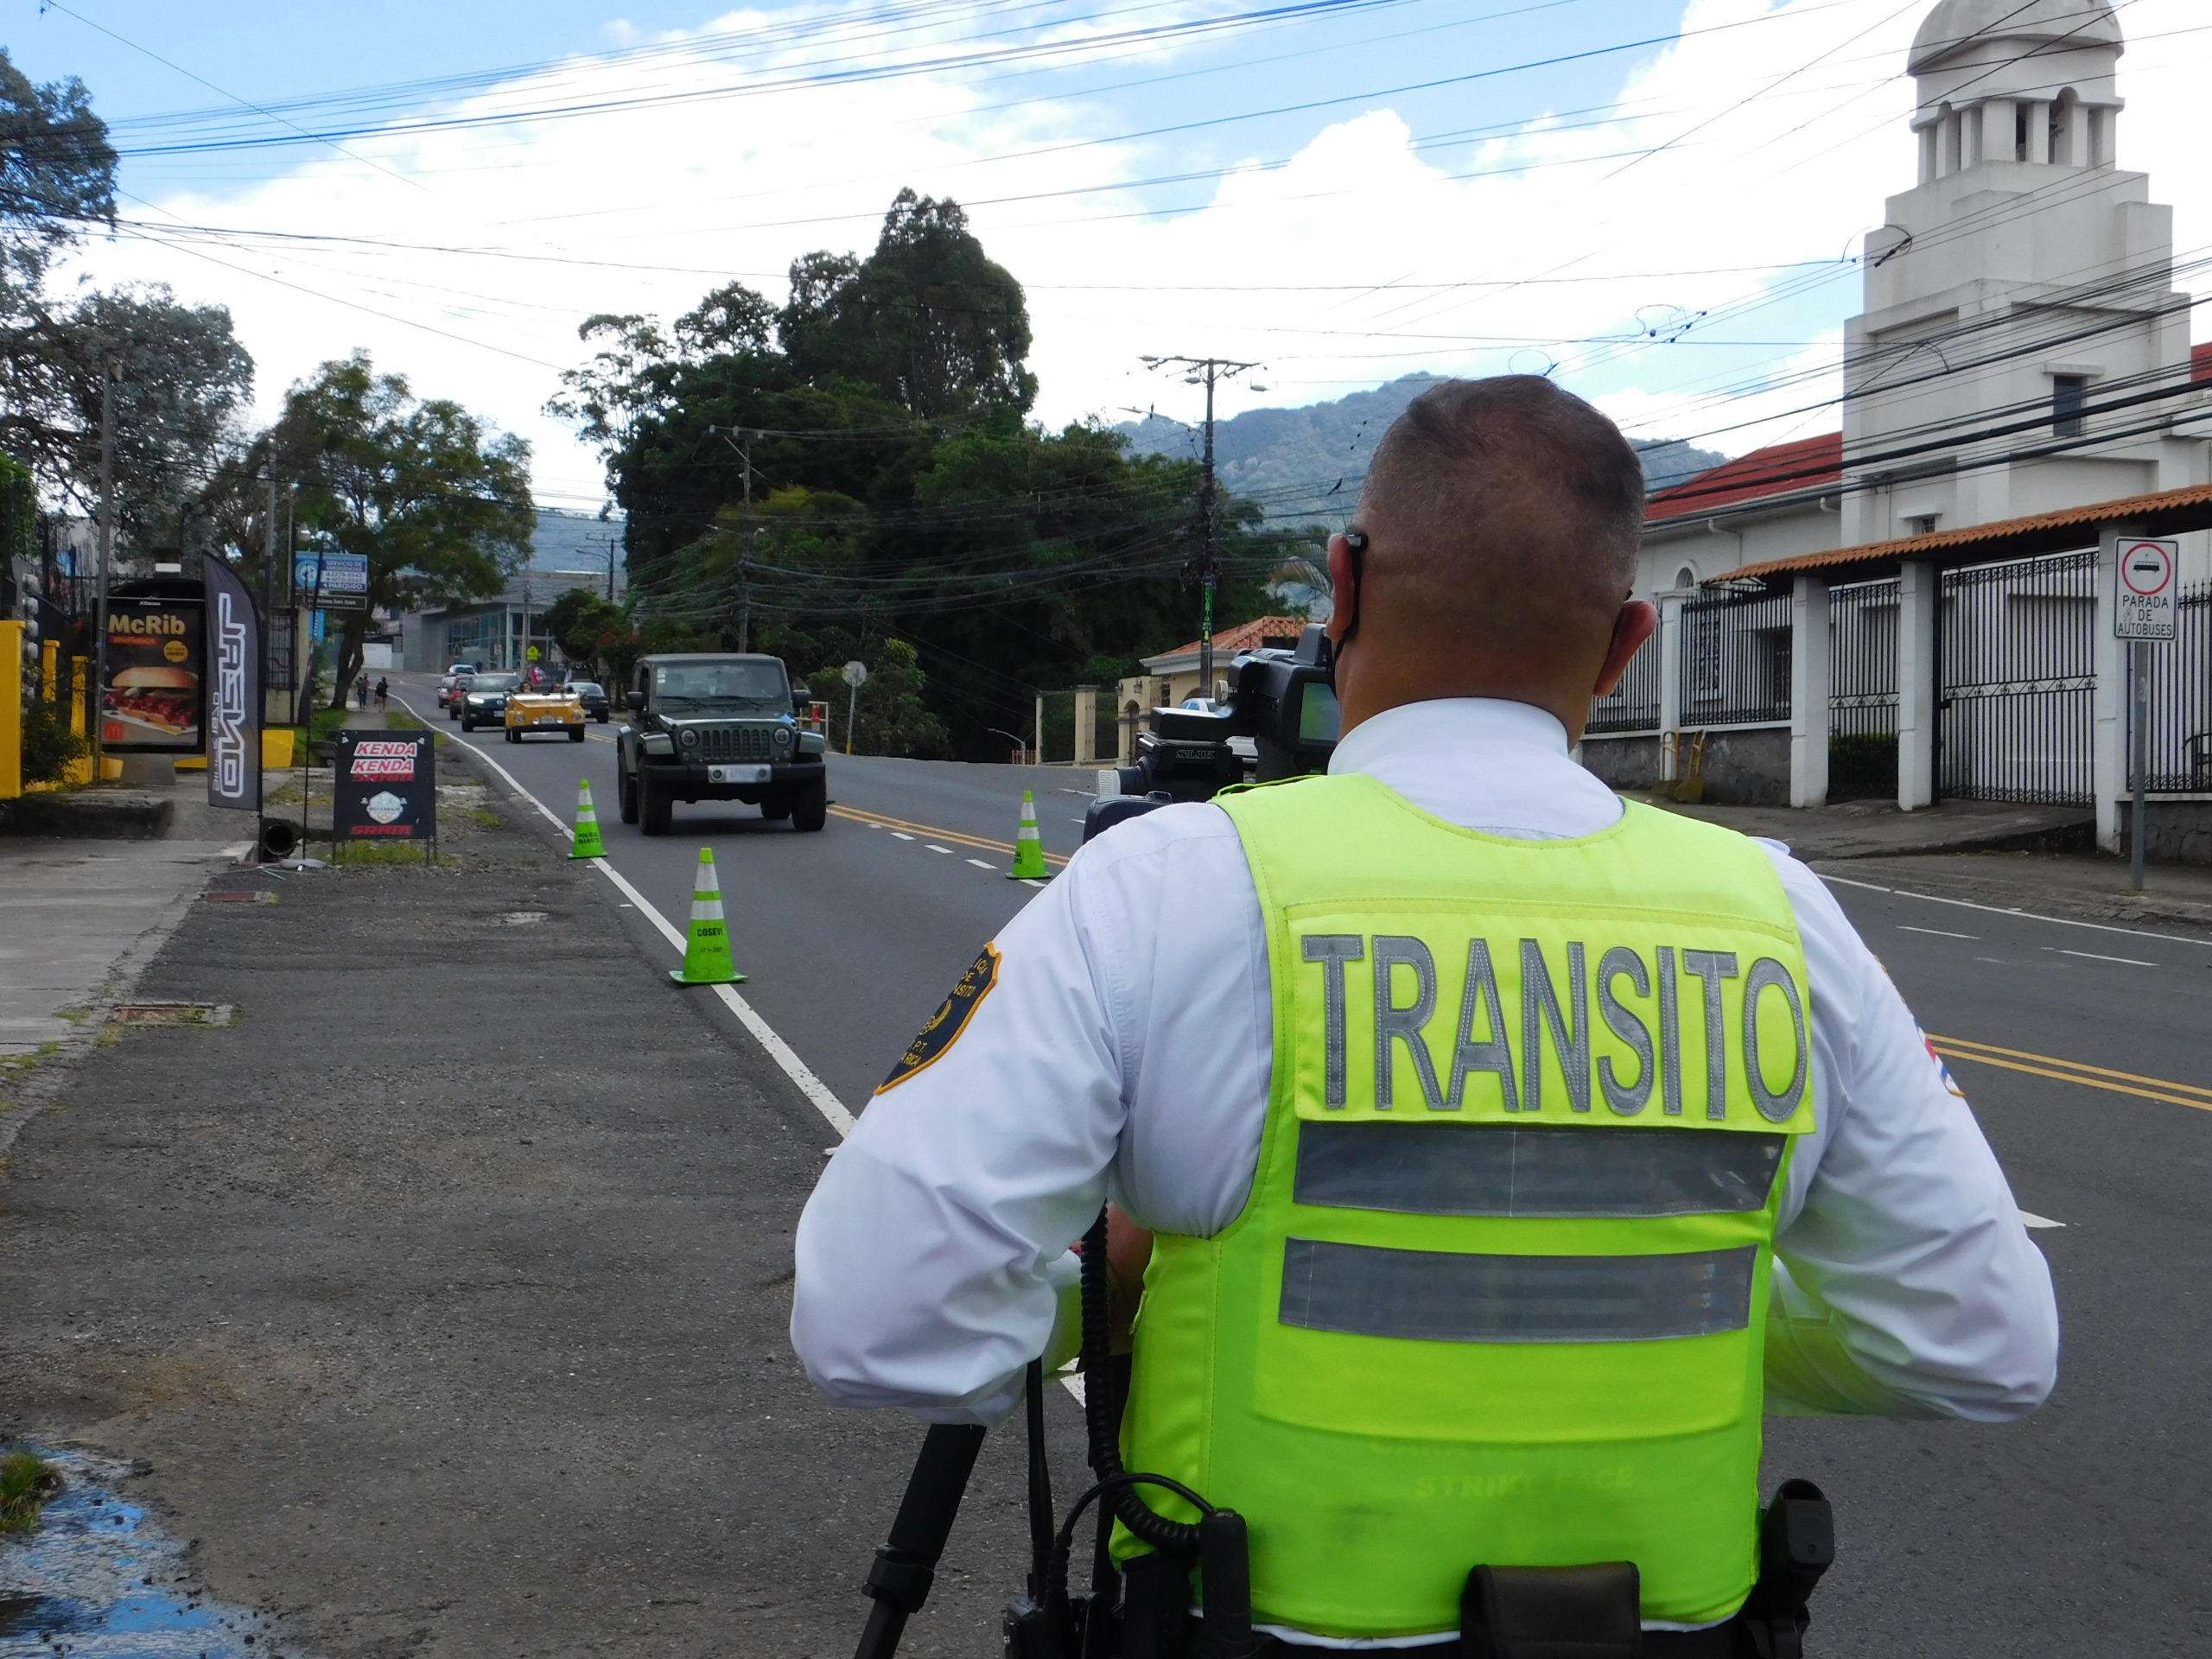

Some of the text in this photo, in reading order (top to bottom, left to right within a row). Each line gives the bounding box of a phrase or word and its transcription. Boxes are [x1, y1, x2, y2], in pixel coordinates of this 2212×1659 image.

[2122, 594, 2169, 608] PARADA
[2138, 609, 2152, 621] DE
[108, 613, 186, 635] McRib
[2117, 623, 2172, 636] AUTOBUSES
[354, 742, 416, 756] KENDA
[1176, 749, 1215, 759] SLIK
[351, 760, 414, 772] KENDA
[352, 825, 413, 835] SRAM
[696, 927, 723, 937] COSEVI
[1301, 934, 1808, 1122] TRANSITO
